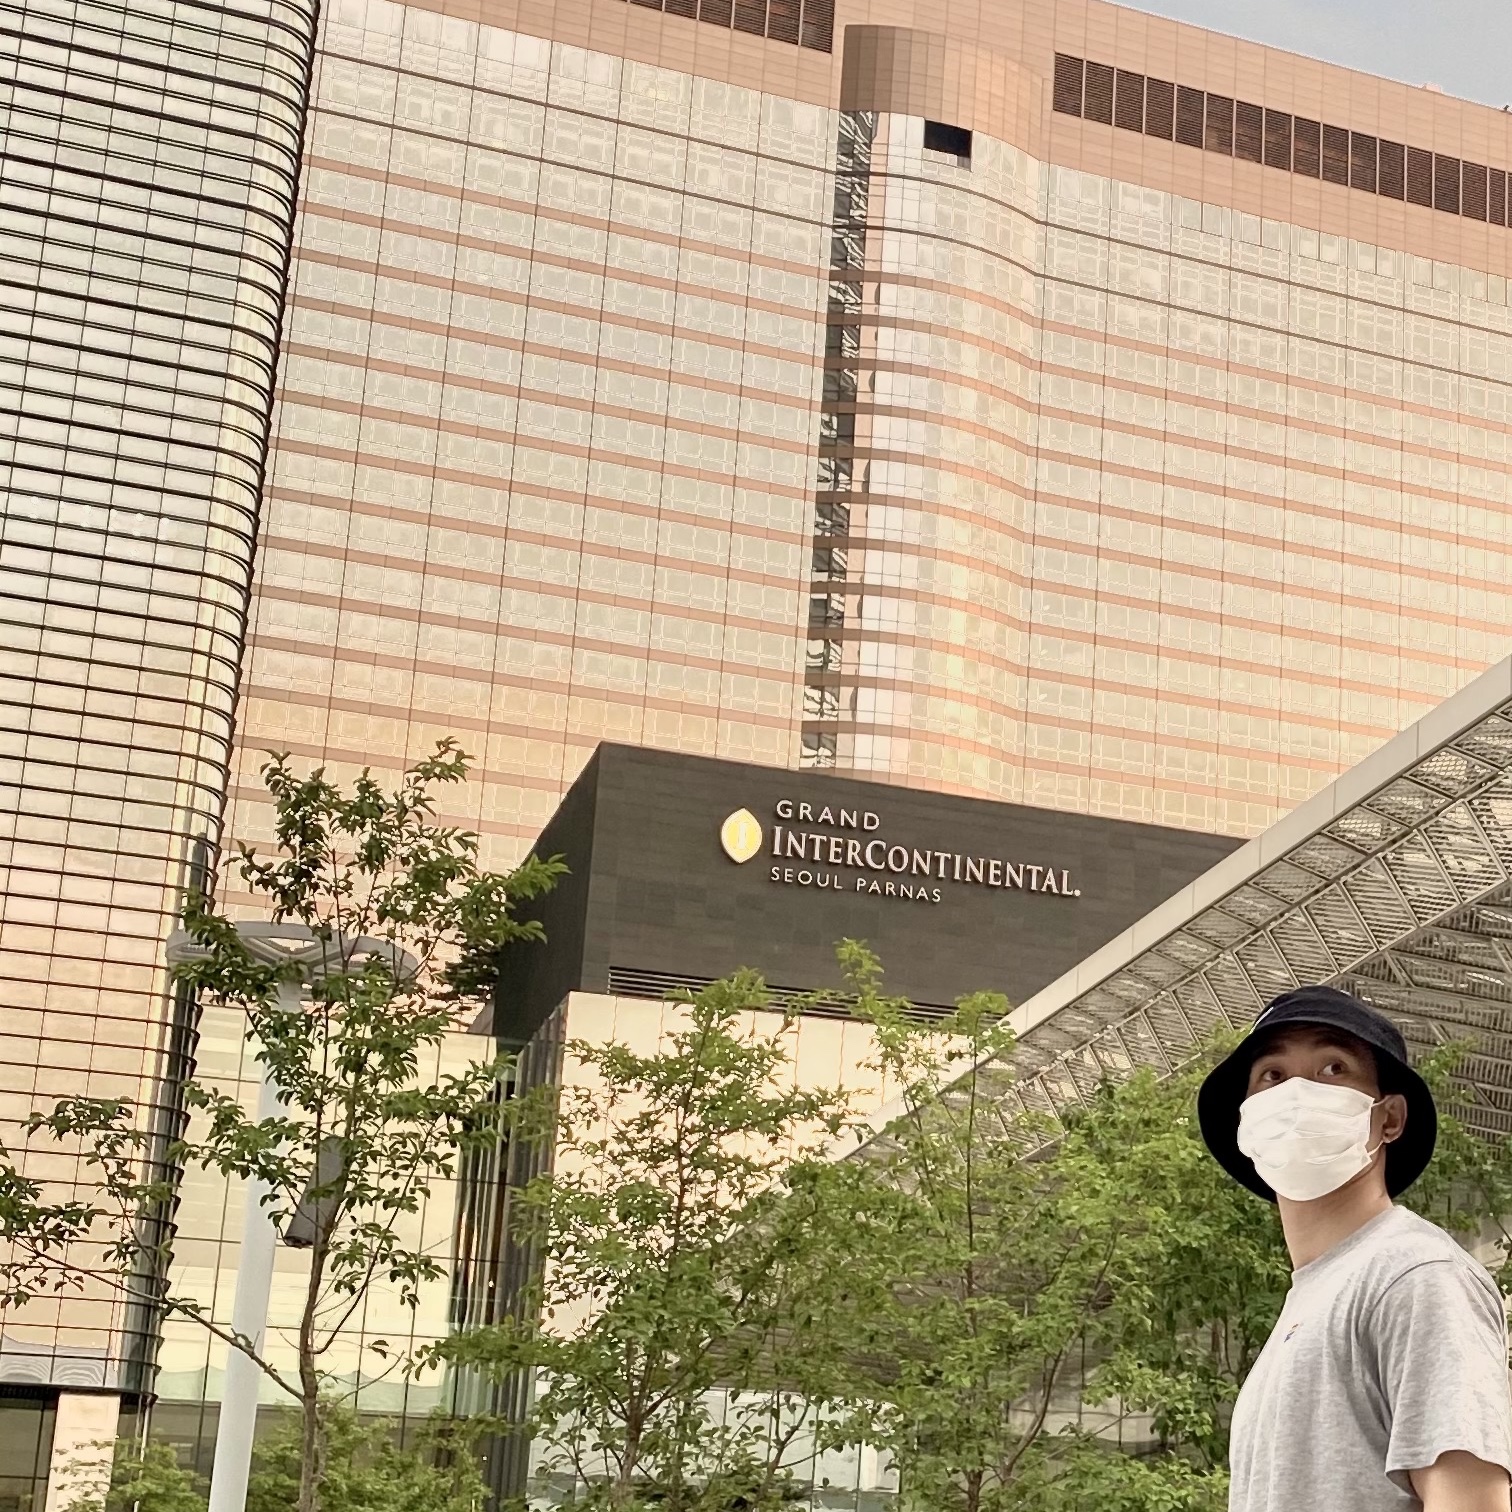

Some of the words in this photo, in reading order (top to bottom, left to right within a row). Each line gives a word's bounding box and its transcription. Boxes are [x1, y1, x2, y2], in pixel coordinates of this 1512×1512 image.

[775, 799, 880, 831] GRAND
[770, 866, 844, 890] SEOUL
[856, 877, 942, 903] PARNAS
